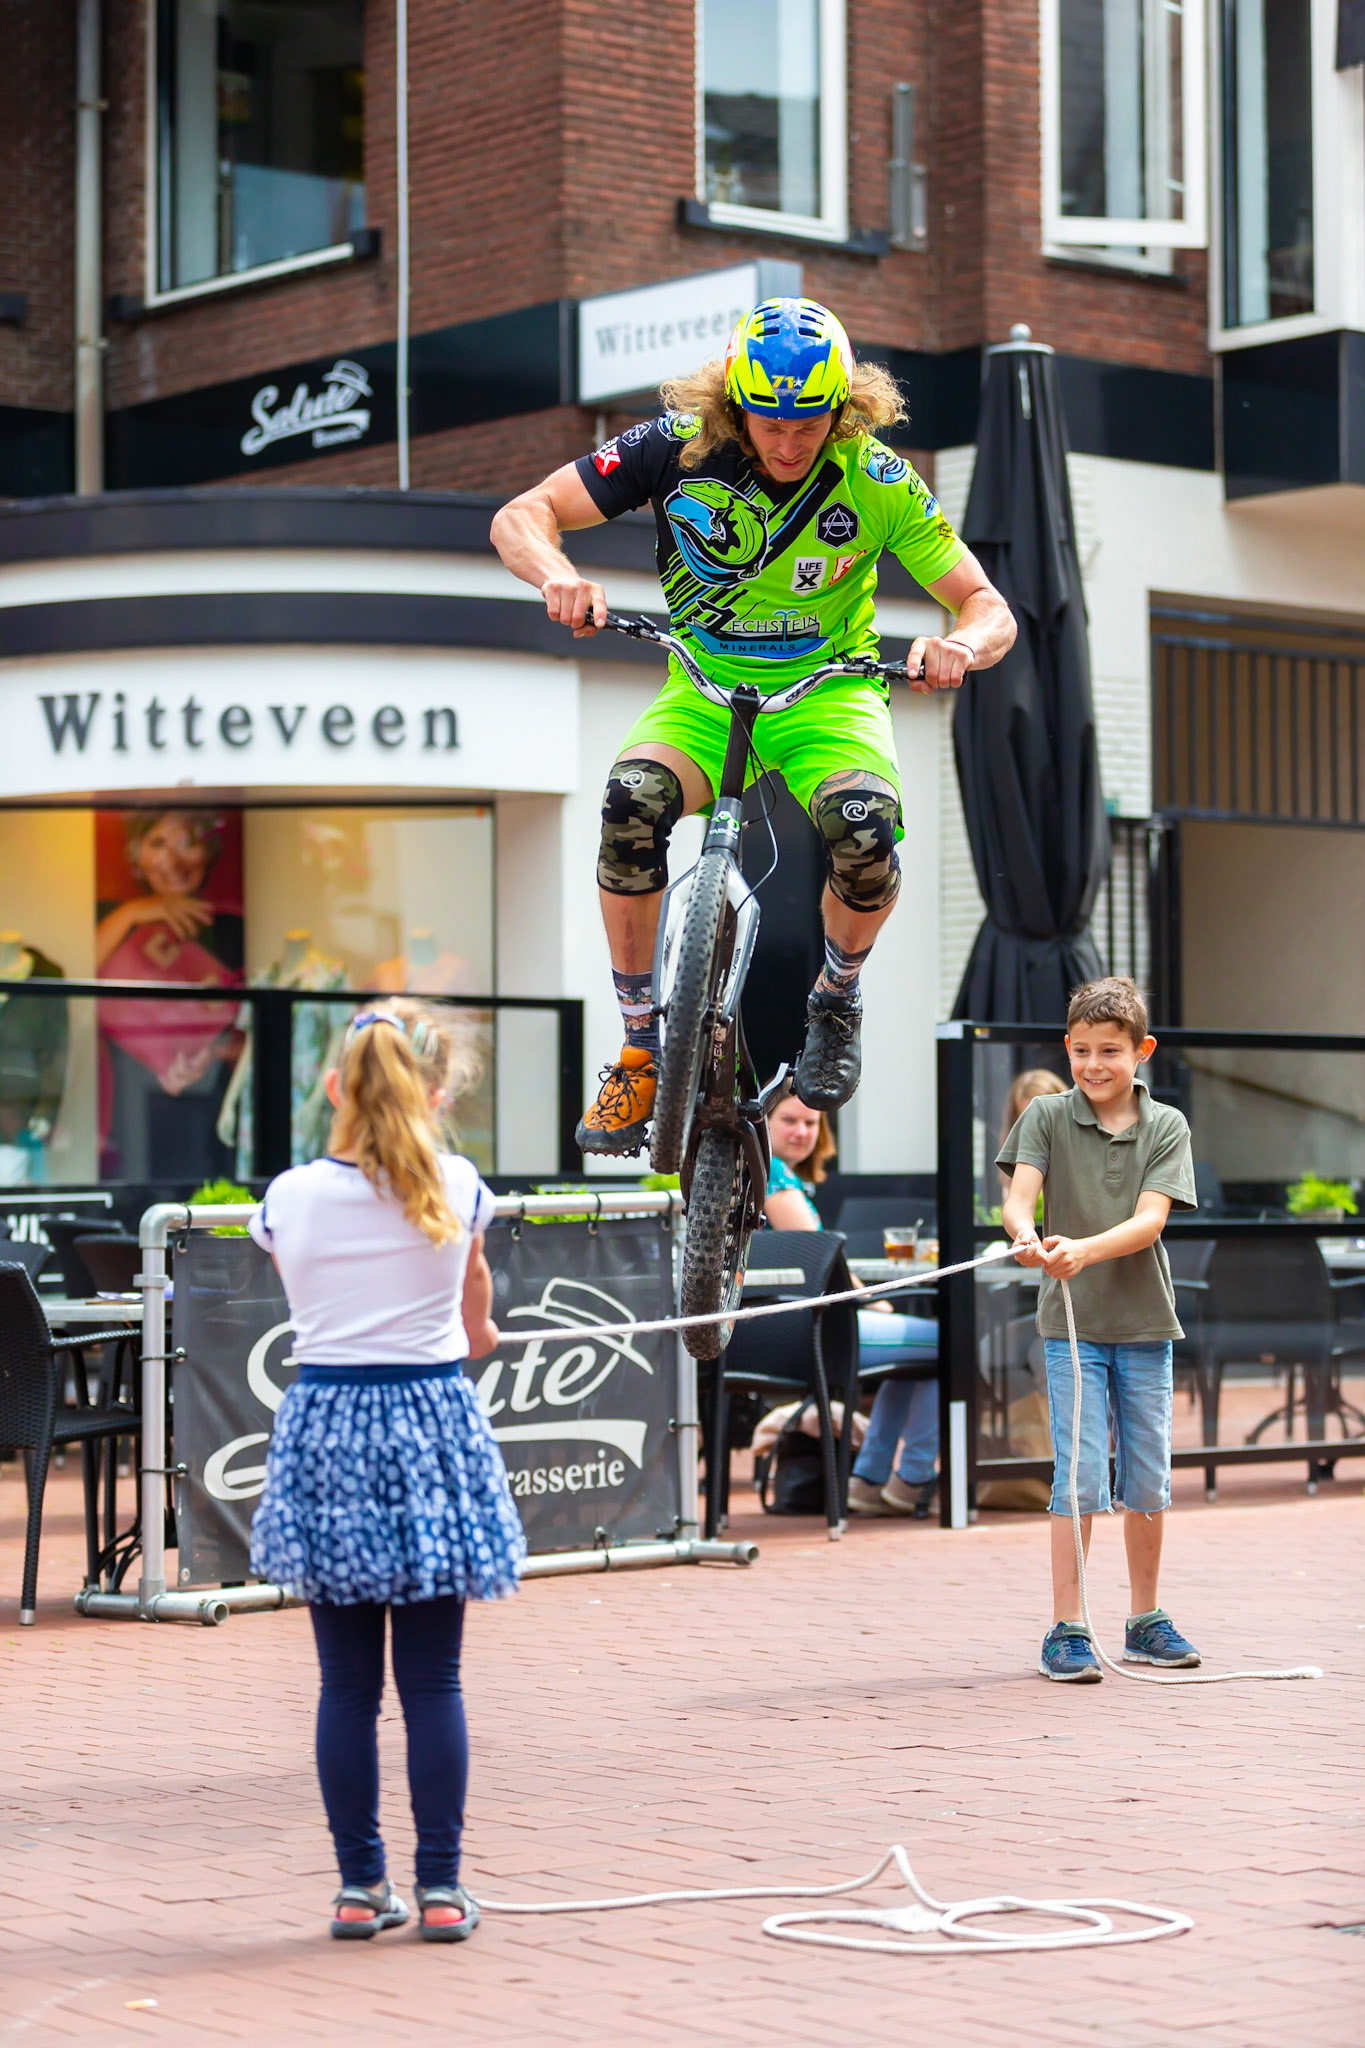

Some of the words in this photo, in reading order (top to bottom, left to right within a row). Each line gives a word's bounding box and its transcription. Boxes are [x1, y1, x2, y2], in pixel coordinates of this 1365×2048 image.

[771, 374, 794, 389] 71
[798, 562, 822, 571] LIFE
[795, 573, 820, 588] X
[720, 642, 796, 652] MINERALS
[39, 693, 461, 752] Witteveen
